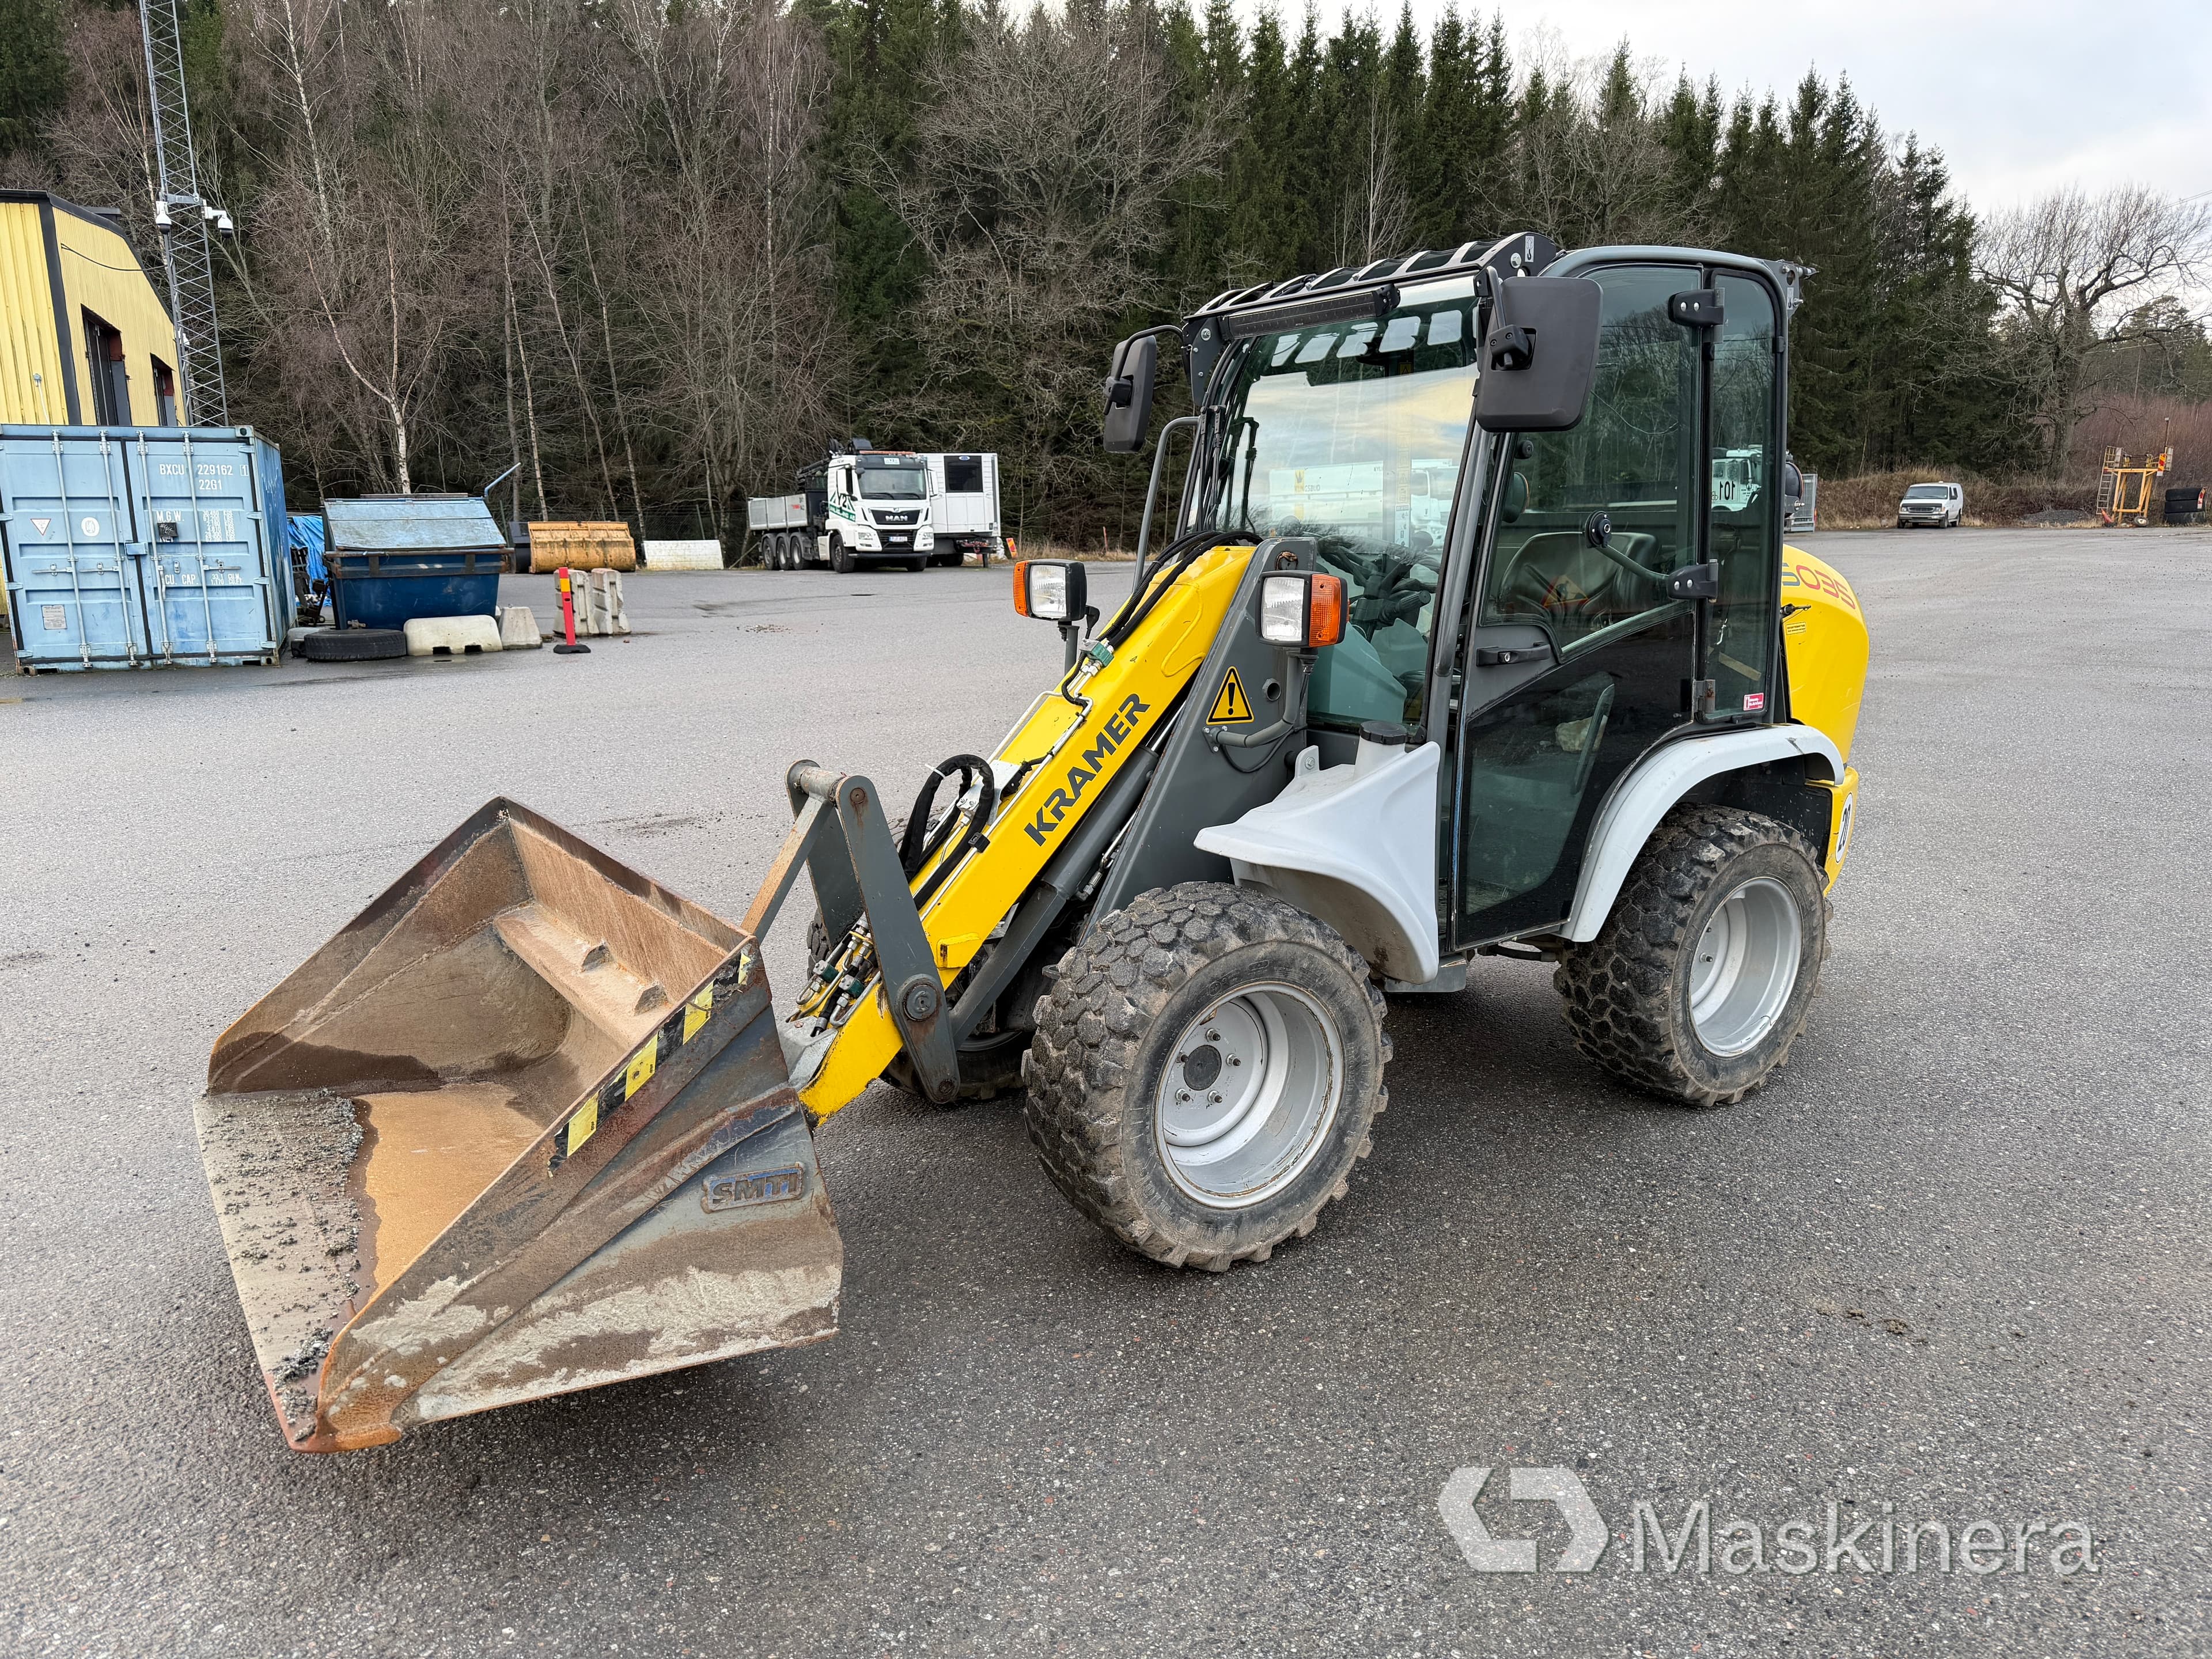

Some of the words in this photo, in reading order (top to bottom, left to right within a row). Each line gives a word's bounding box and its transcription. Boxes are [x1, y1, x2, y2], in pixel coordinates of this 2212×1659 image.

[160, 464, 185, 475] BXCU
[198, 465, 234, 476] 229162
[241, 465, 248, 476] 1
[199, 479, 222, 490] 22G1
[156, 510, 185, 521] M.G.W.
[165, 574, 177, 584] CU.
[181, 574, 199, 585] CAP.
[1024, 693, 1151, 847] KRAMER
[1838, 804, 1851, 853] 20
